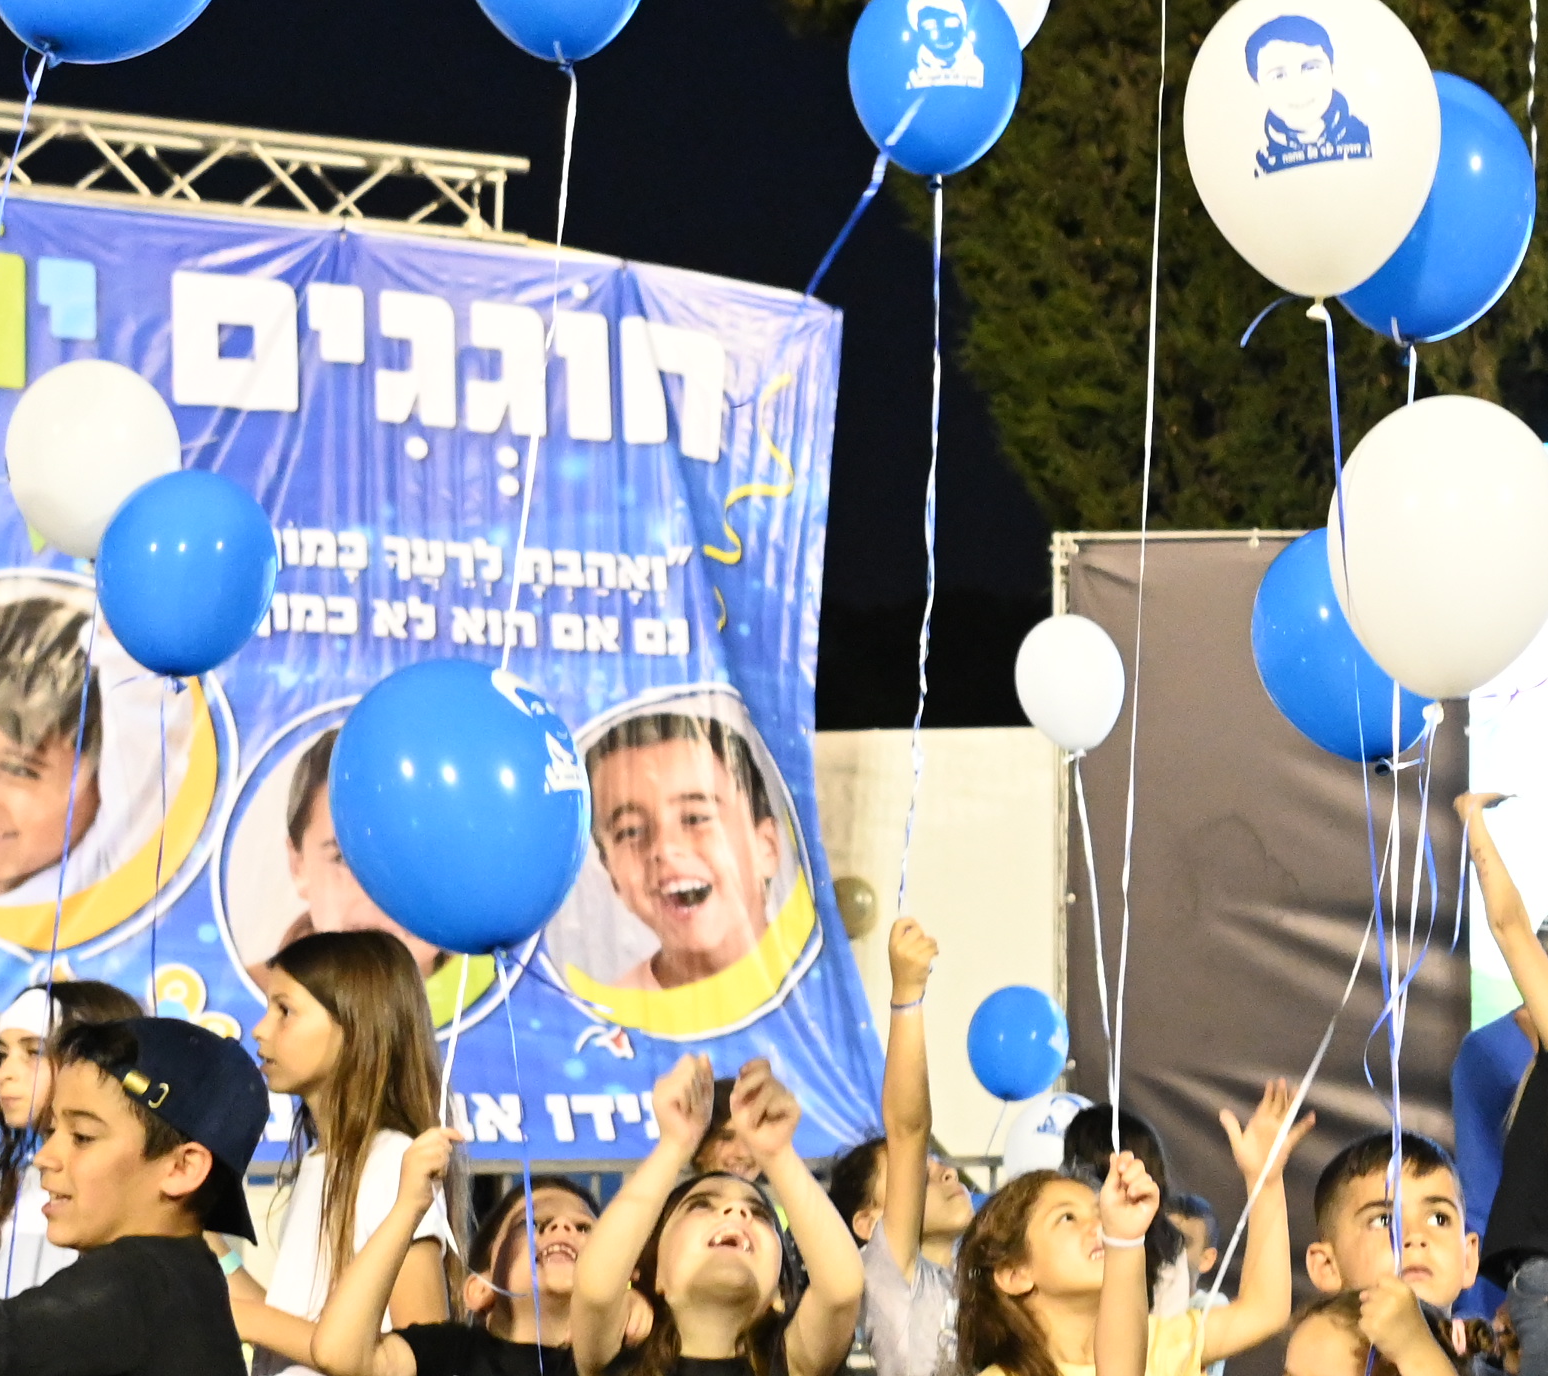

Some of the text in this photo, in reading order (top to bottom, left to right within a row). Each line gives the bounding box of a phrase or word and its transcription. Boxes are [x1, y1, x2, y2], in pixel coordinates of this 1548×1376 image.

[373, 596, 437, 640] לא
[452, 606, 537, 648] הוא
[552, 613, 620, 653] אם
[634, 618, 690, 655] גם
